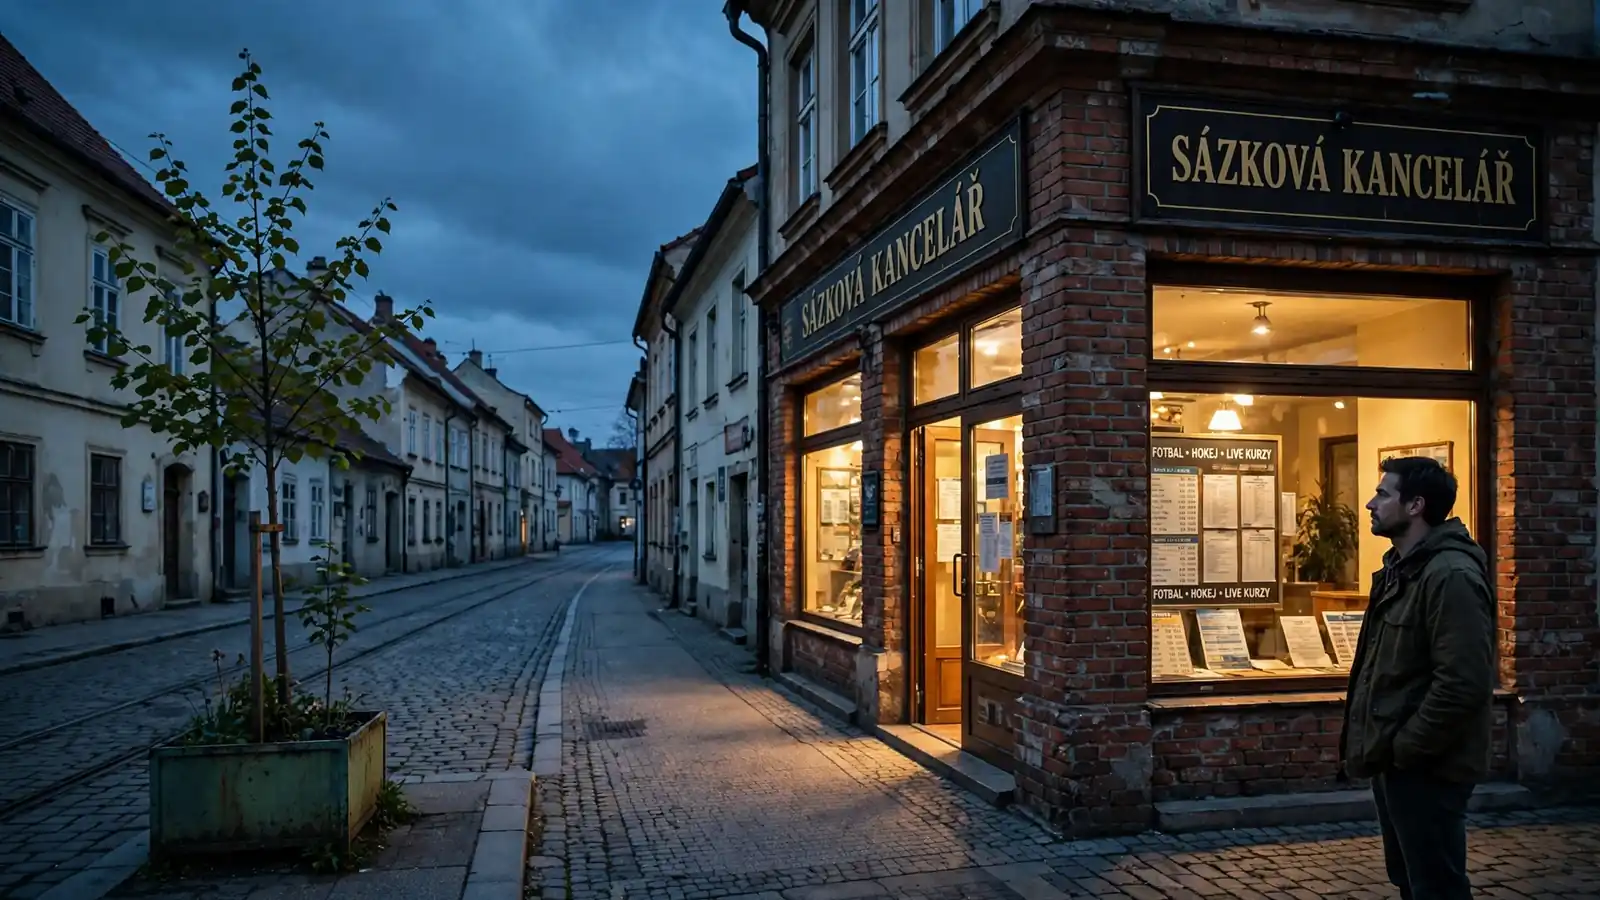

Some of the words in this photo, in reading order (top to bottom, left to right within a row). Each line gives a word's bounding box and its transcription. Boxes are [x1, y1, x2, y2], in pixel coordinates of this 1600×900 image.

[1172, 125, 1331, 193] SÁZKOVÁ
[1342, 148, 1516, 205] KANCELÁŘ
[801, 254, 865, 339] SÁZKOVÁ
[871, 168, 985, 296] KANCELÁŘ
[1152, 446, 1184, 459] FOTBAL
[1191, 447, 1218, 460] HOKEJ
[1226, 449, 1244, 460] LIVE
[1245, 449, 1272, 461] KURZY
[1153, 588, 1183, 600] FOTBAL
[1190, 588, 1217, 599] HOKEJ
[1224, 588, 1242, 599] LIVE
[1243, 587, 1271, 598] KURZY
